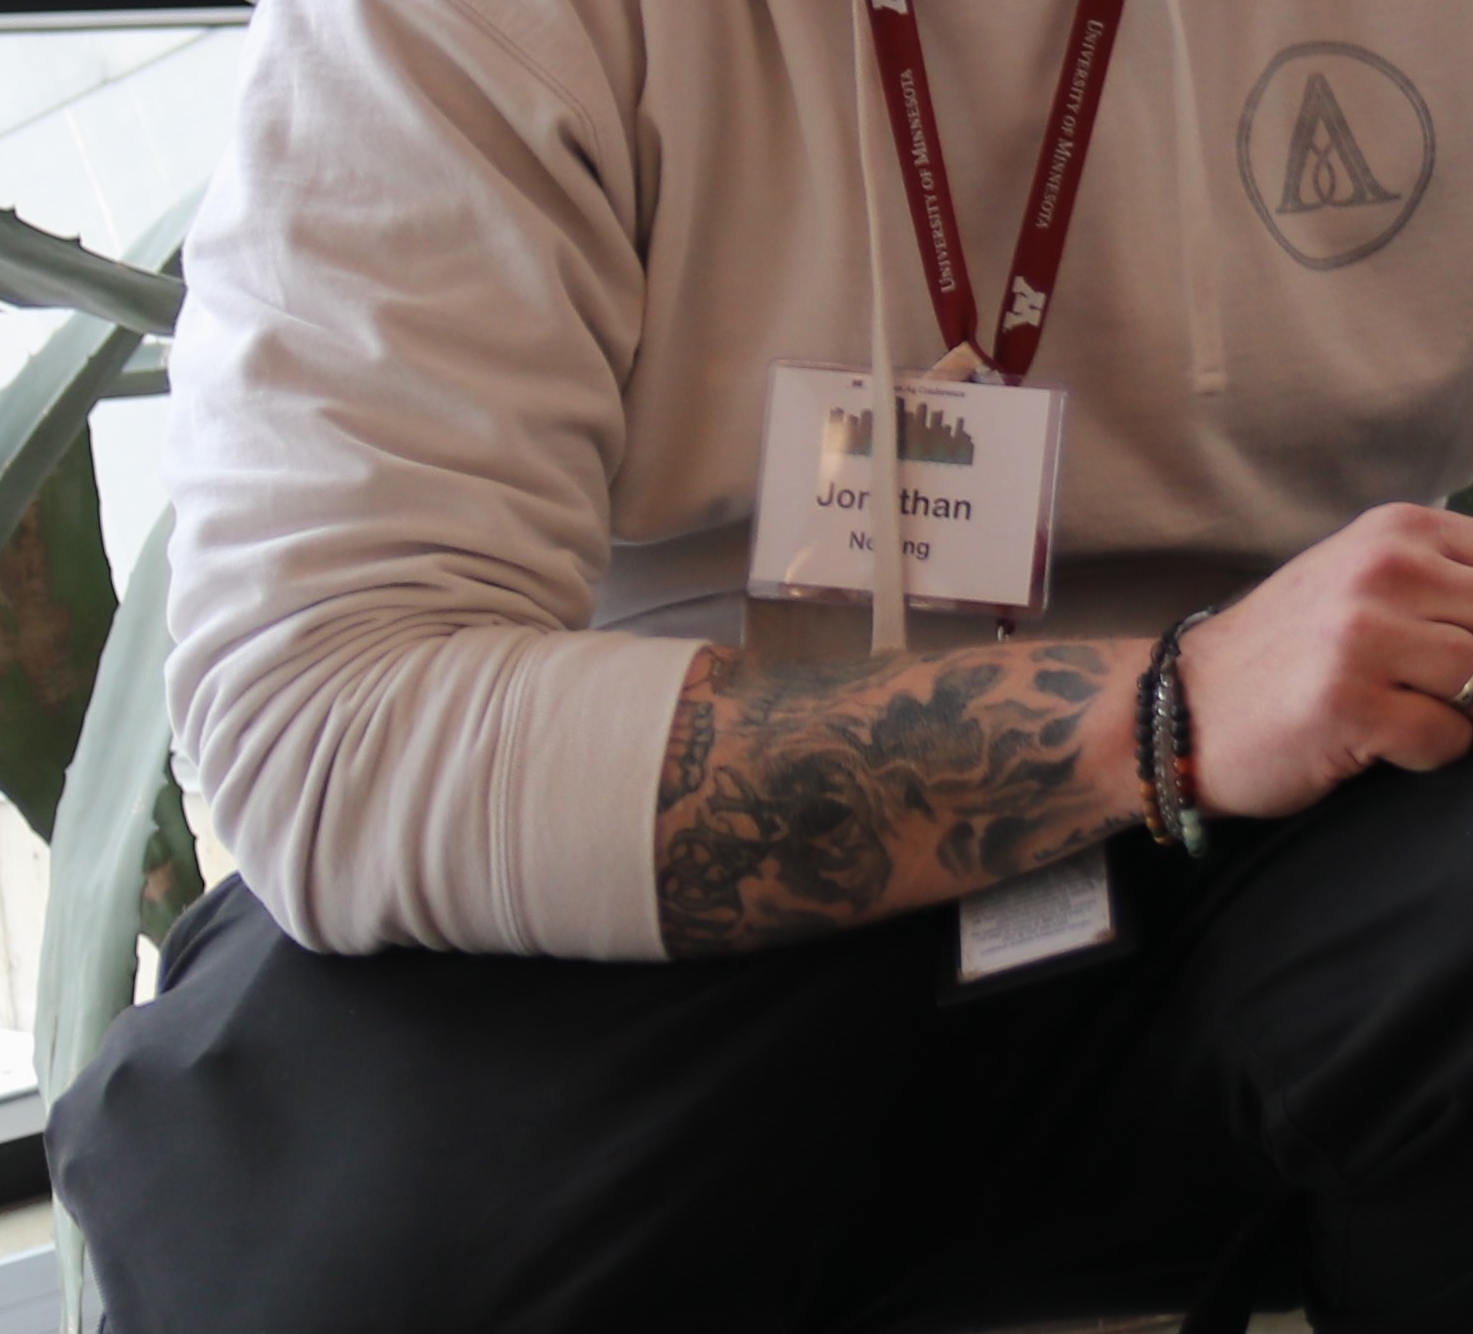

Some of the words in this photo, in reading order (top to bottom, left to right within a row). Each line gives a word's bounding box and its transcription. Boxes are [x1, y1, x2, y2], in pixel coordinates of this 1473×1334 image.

[1066, 19, 1104, 114] UNIVERSITY
[900, 68, 929, 166] MINNESOTA
[1061, 116, 1076, 136] OF
[918, 169, 935, 191] OF
[1036, 137, 1074, 228] MINNESOTA
[924, 194, 956, 293] UNIVERSITY
[817, 482, 972, 520] Jonthan
